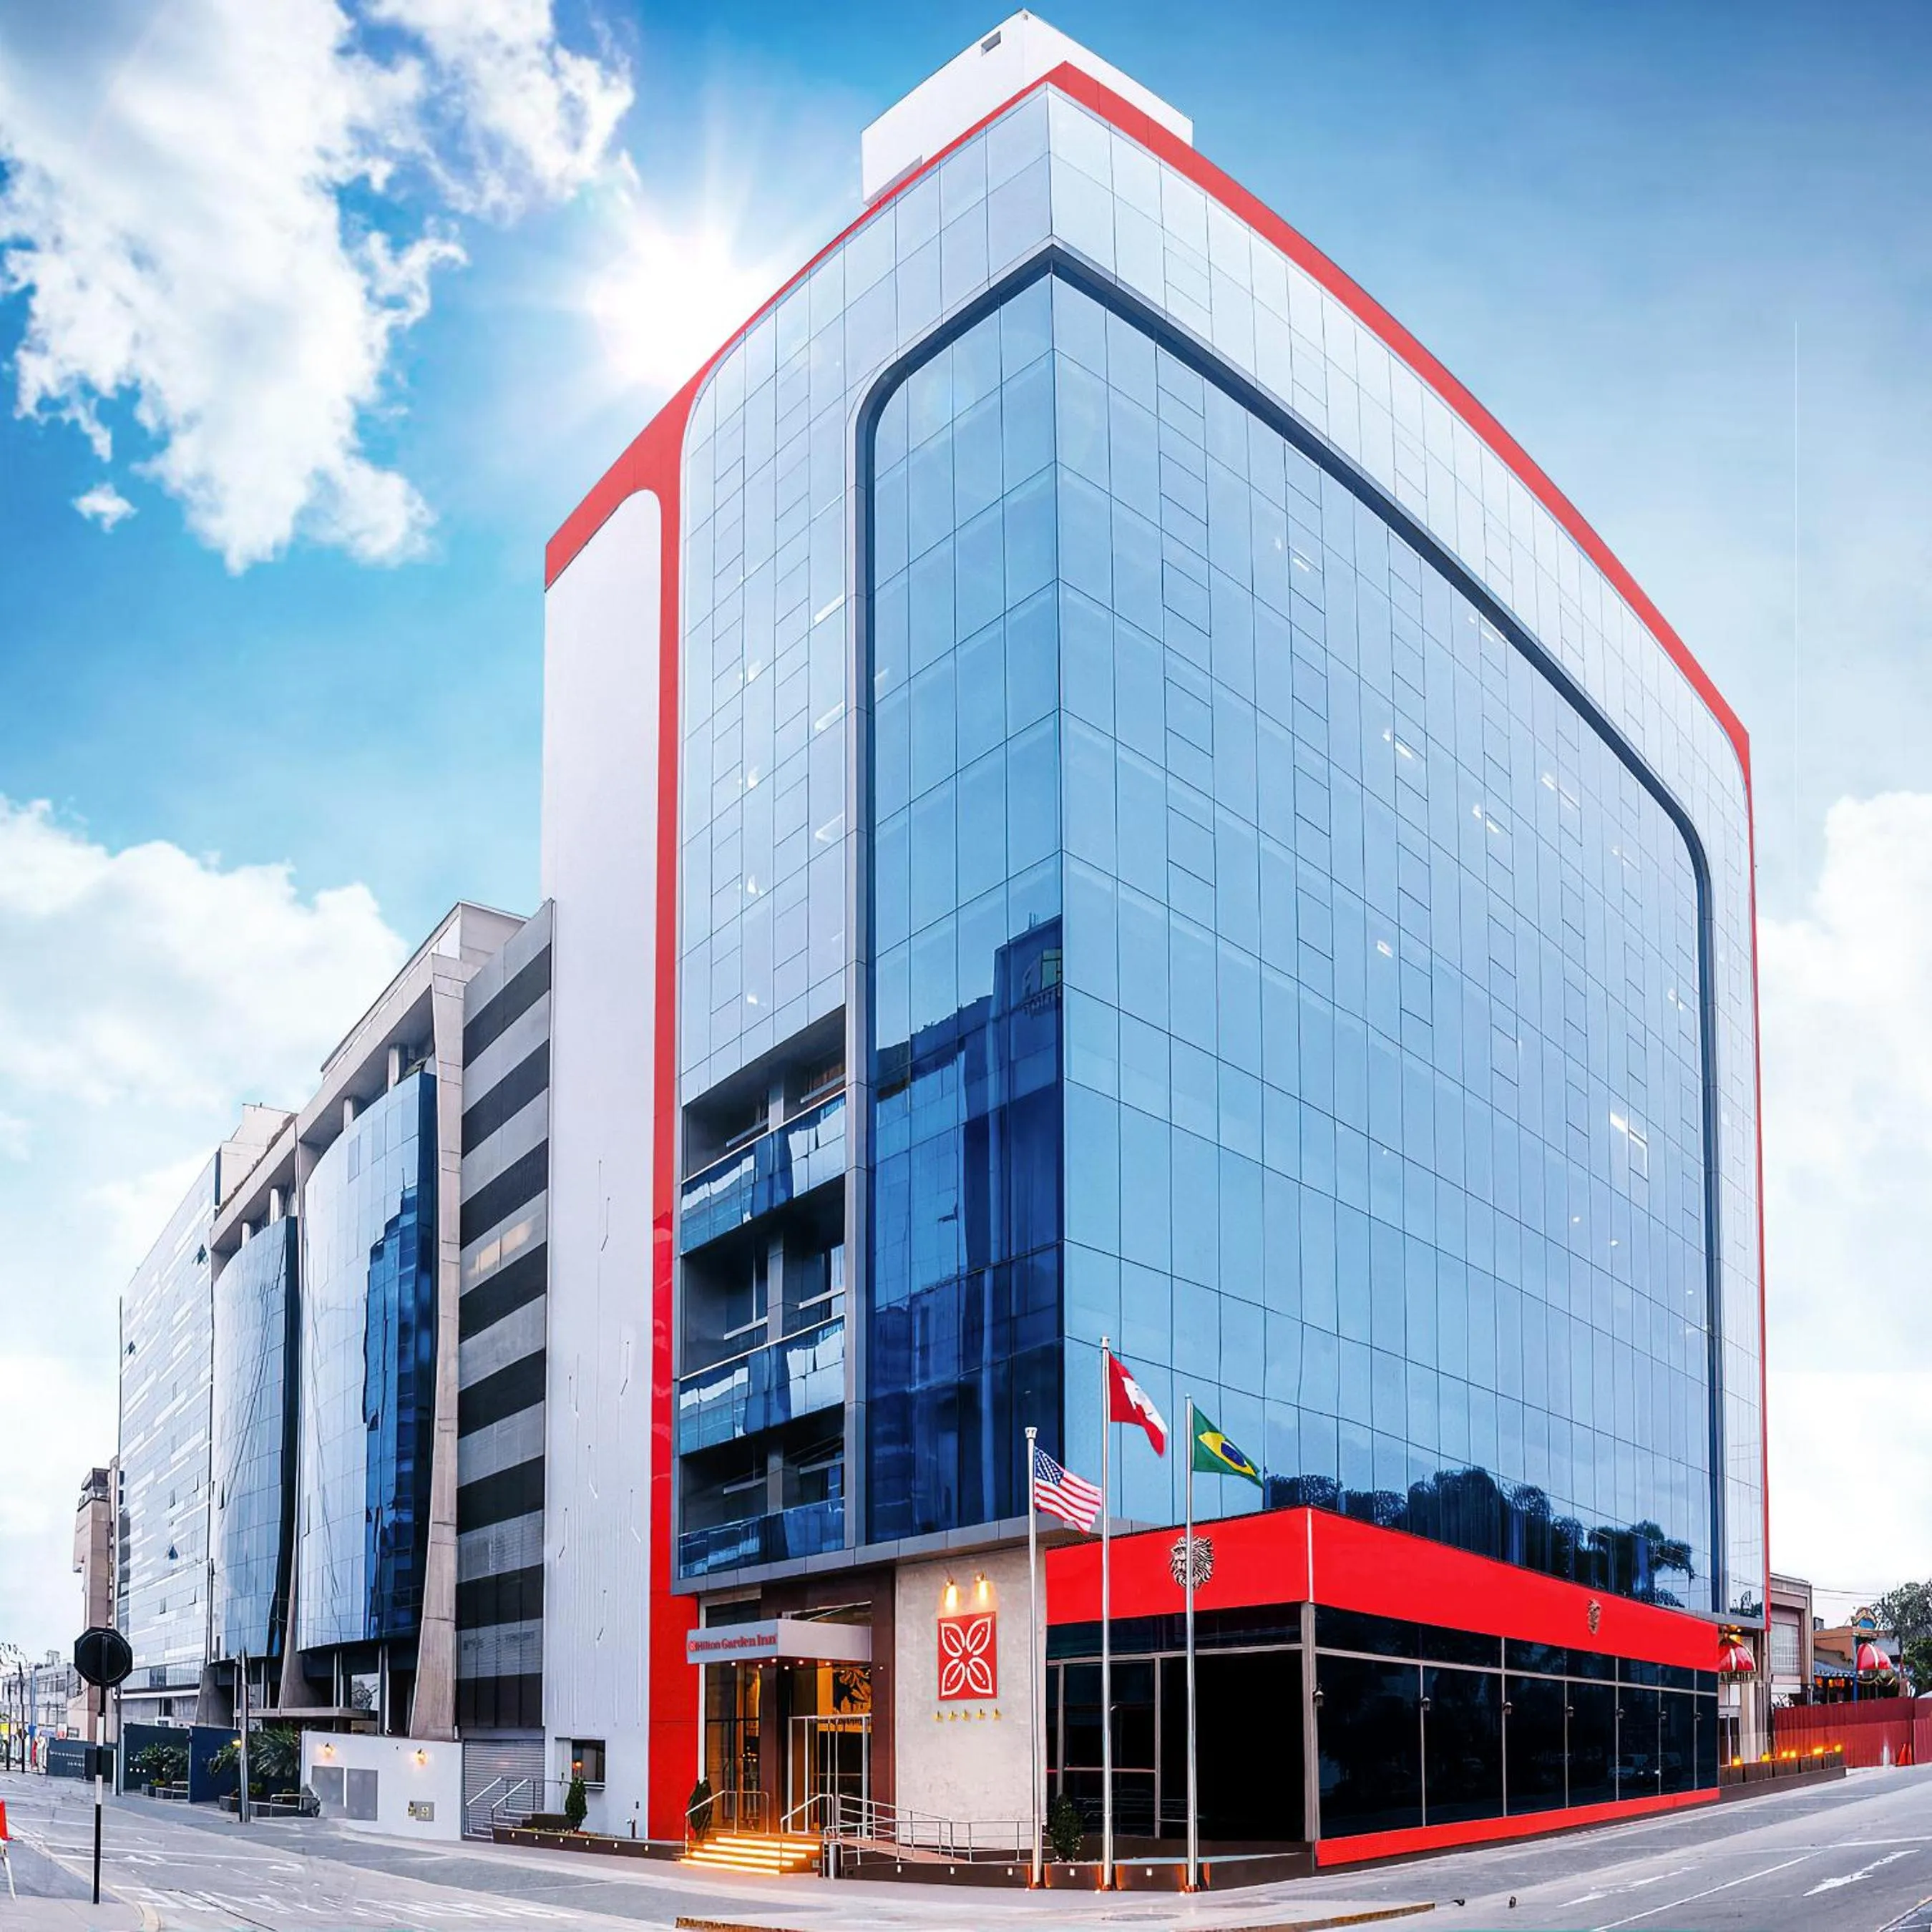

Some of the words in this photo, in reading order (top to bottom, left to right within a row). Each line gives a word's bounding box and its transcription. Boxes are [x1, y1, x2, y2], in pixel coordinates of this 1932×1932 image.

[697, 1639, 721, 1651] Hilton
[721, 1636, 756, 1649] Garden
[756, 1634, 776, 1646] Inn
